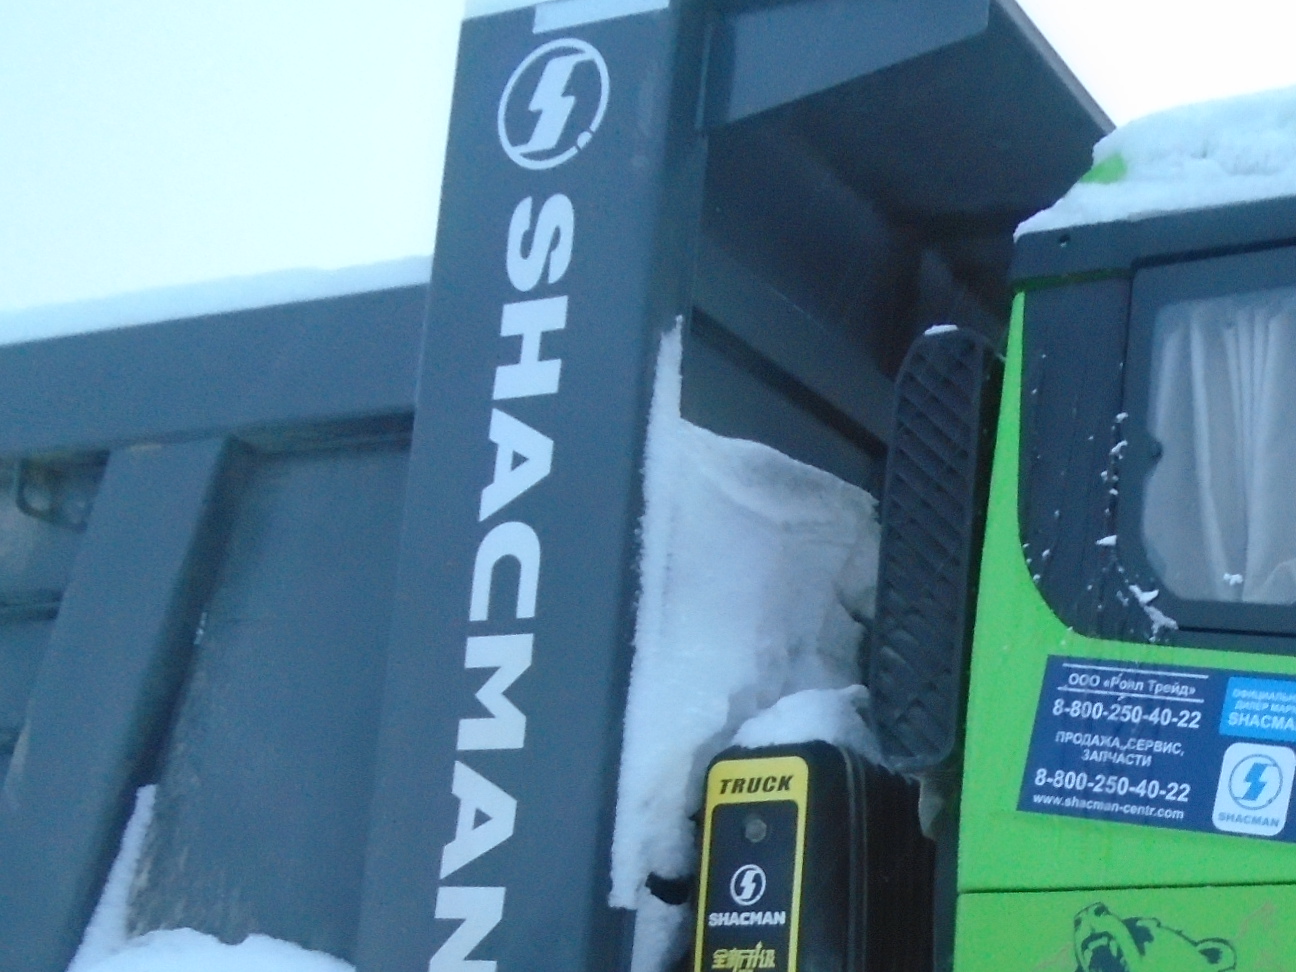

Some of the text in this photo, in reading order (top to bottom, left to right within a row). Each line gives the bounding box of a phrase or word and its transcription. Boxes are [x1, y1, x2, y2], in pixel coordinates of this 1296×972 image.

[1068, 673, 1100, 687] ООО
[1148, 680, 1196, 697] Трейд»
[1053, 698, 1202, 729] 8-800-250-40-22
[1081, 748, 1153, 767] ЗАПЧАСТИ
[1126, 738, 1185, 757] СЕРВИС,
[719, 775, 794, 795] TRUCK
[1034, 768, 1191, 803] 8-800-250-40-22
[1032, 794, 1184, 820] www.shacman-centr.com
[1218, 812, 1280, 827] SHACMAN
[709, 910, 786, 926] SHACMAN
